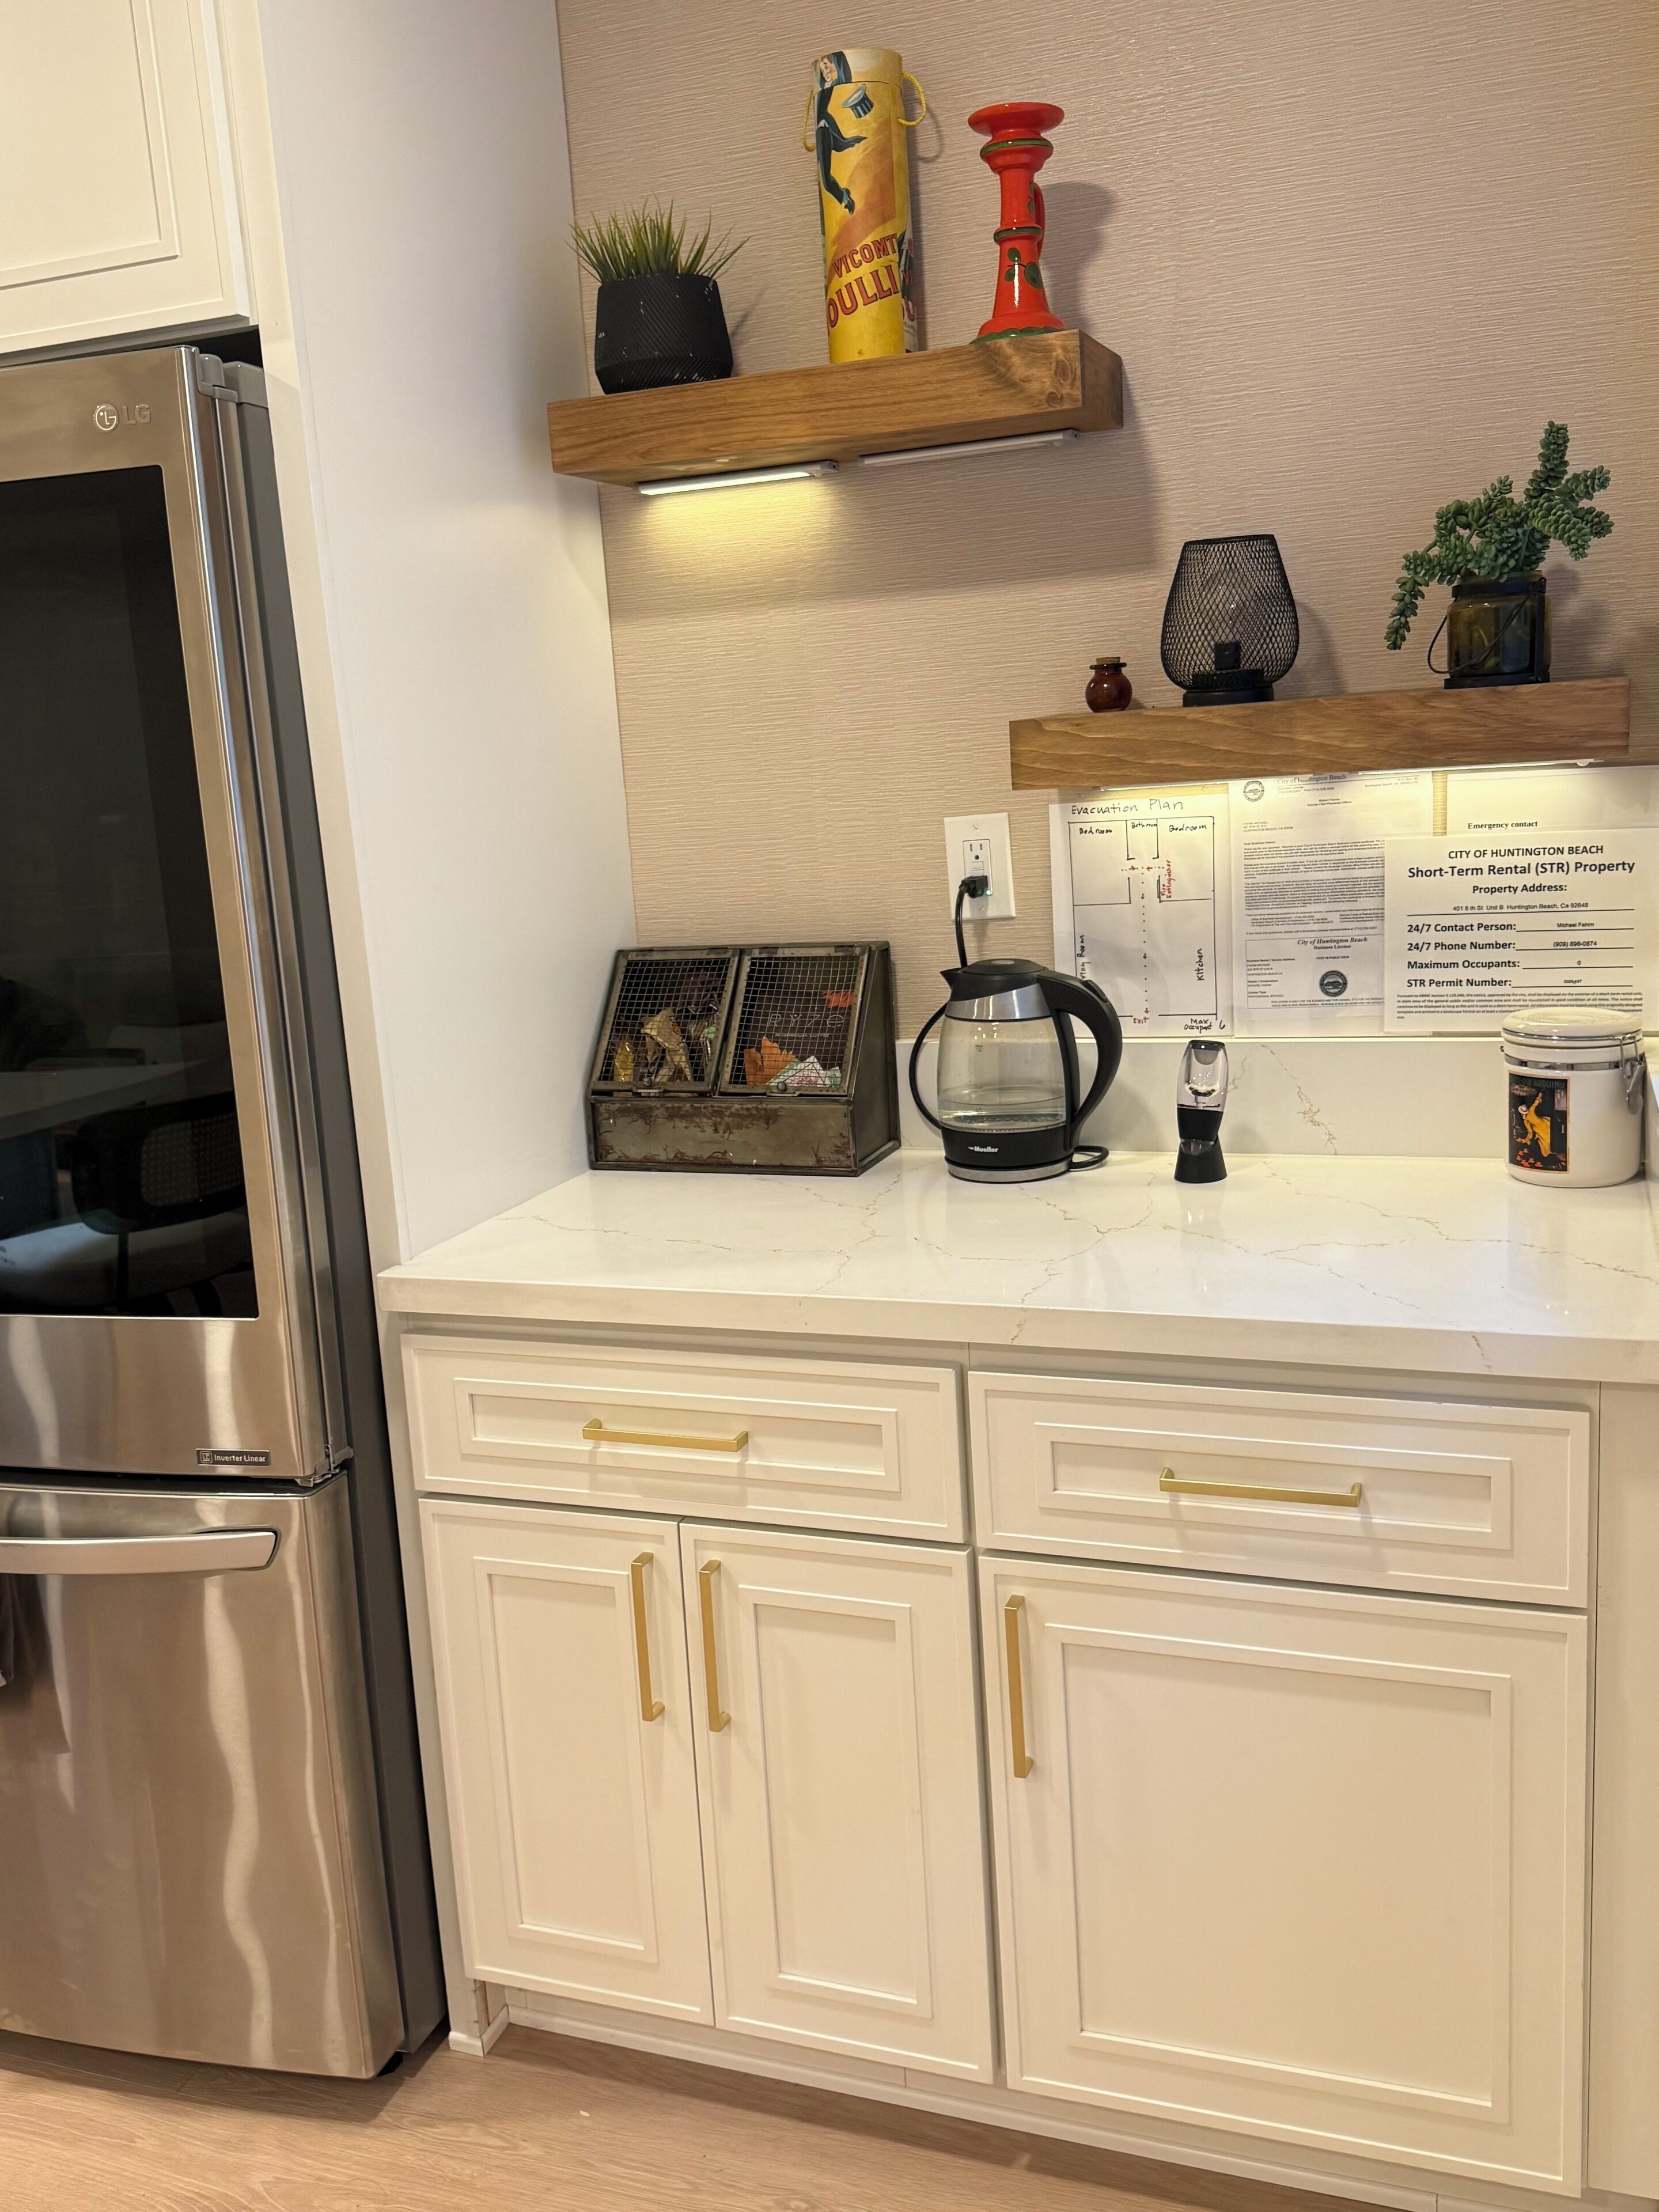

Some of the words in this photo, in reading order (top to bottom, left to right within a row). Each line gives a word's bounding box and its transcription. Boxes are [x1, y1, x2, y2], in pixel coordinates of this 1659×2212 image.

[122, 404, 151, 426] LG
[1071, 802, 1138, 815] Evacuation
[1149, 799, 1183, 810] Plan
[1448, 850, 1471, 859] CITY
[1474, 849, 1488, 858] OF
[1491, 847, 1564, 857] HUNTINGTON
[1567, 845, 1603, 855] BEACH
[1408, 866, 1483, 878] Short-Term
[1488, 863, 1531, 875] Rental
[1535, 861, 1570, 876] (STR)
[1574, 861, 1635, 874] Property
[1472, 885, 1518, 895] Property
[1521, 883, 1567, 892] Address:
[1407, 923, 1431, 934] 24/7
[1434, 923, 1474, 932] Contact
[1478, 923, 1516, 931] Person:
[1407, 942, 1431, 952] 24/7
[1434, 942, 1466, 950] Phone
[1469, 941, 1516, 949] Number:
[1407, 960, 1459, 969] Maximum
[1462, 960, 1520, 969] Occupants:
[1407, 979, 1426, 987] STR
[1429, 978, 1463, 987] Permit
[1466, 978, 1512, 987] Number:
[214, 1454, 243, 1462] Inverter
[244, 1455, 266, 1463] Linear
